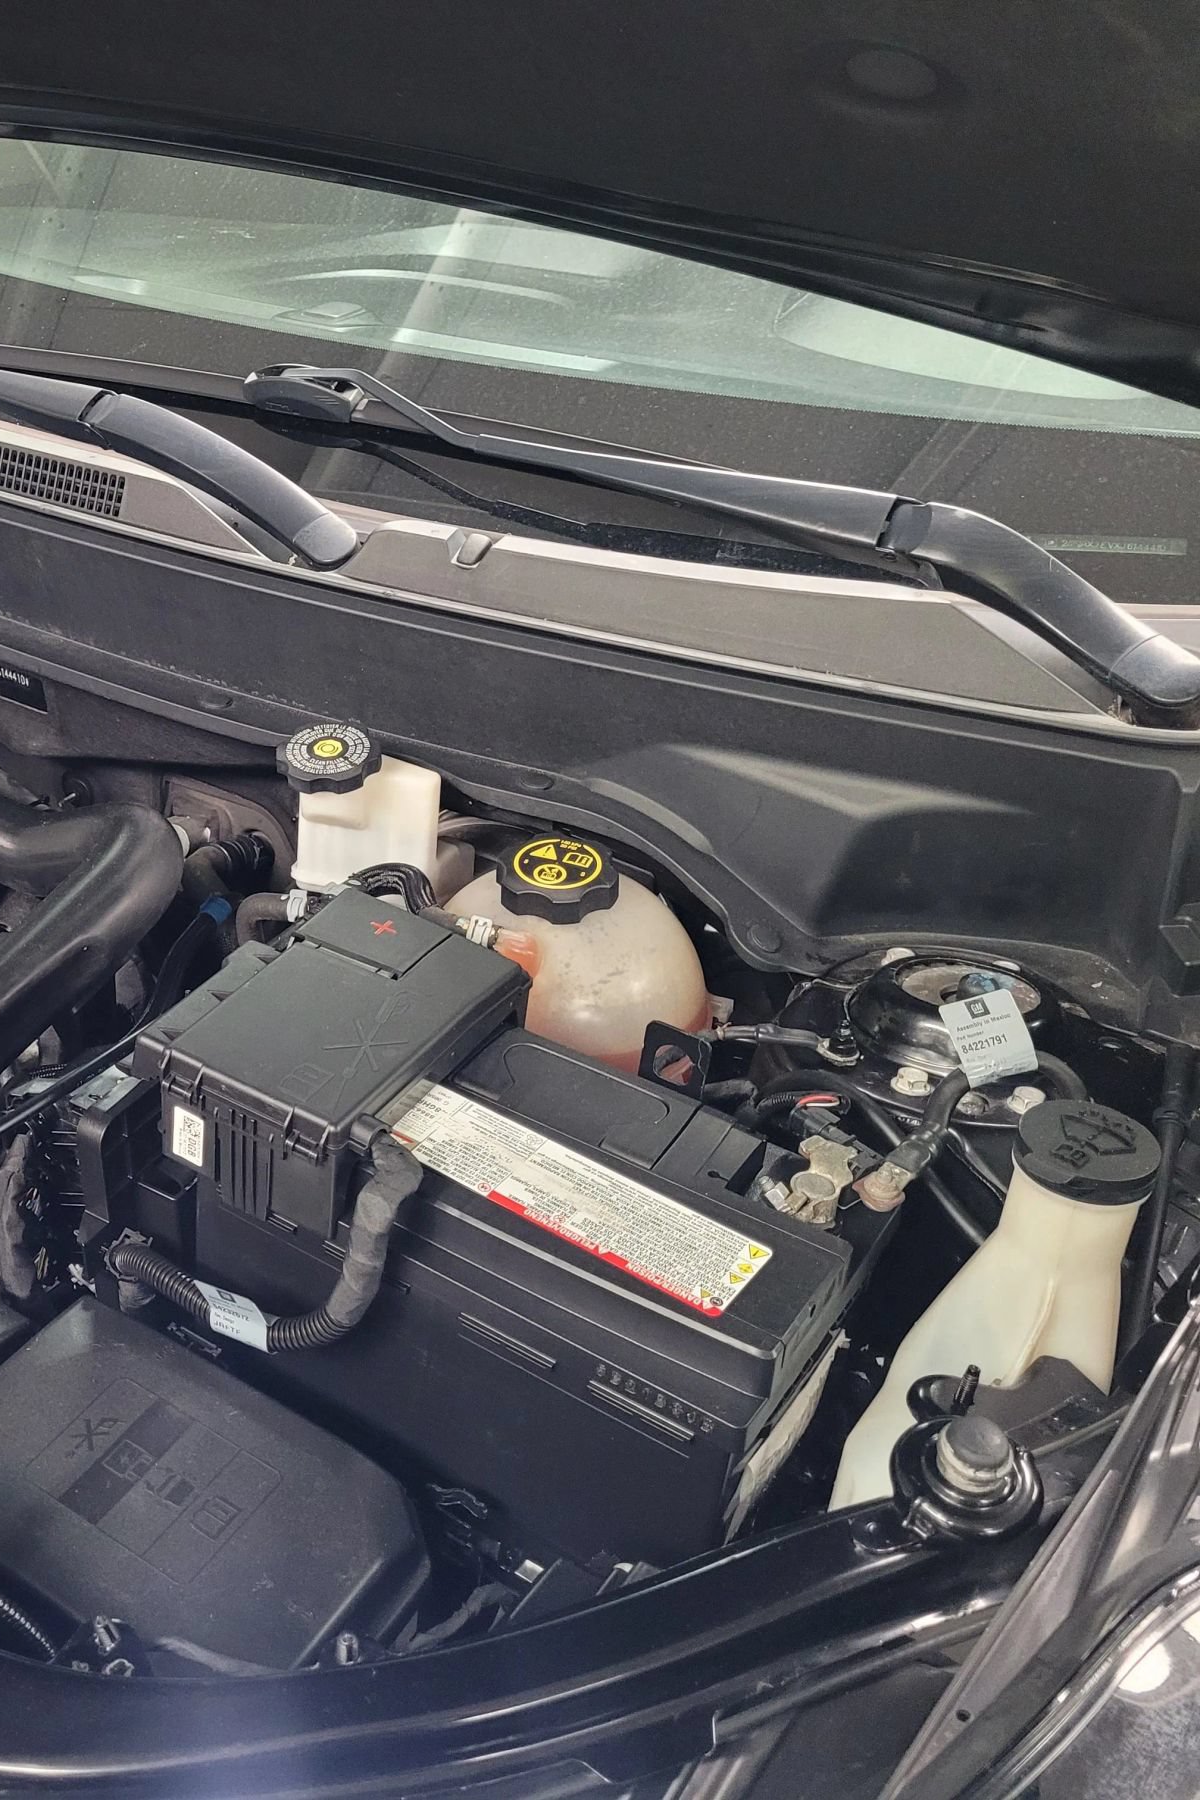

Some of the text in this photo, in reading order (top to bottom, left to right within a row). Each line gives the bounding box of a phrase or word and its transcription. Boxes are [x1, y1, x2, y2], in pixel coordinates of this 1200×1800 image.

[961, 1033, 1008, 1054] 84221791
[522, 1208, 596, 1250] PELIGRO/VENENO
[624, 1261, 702, 1305] DANGER/POISON
